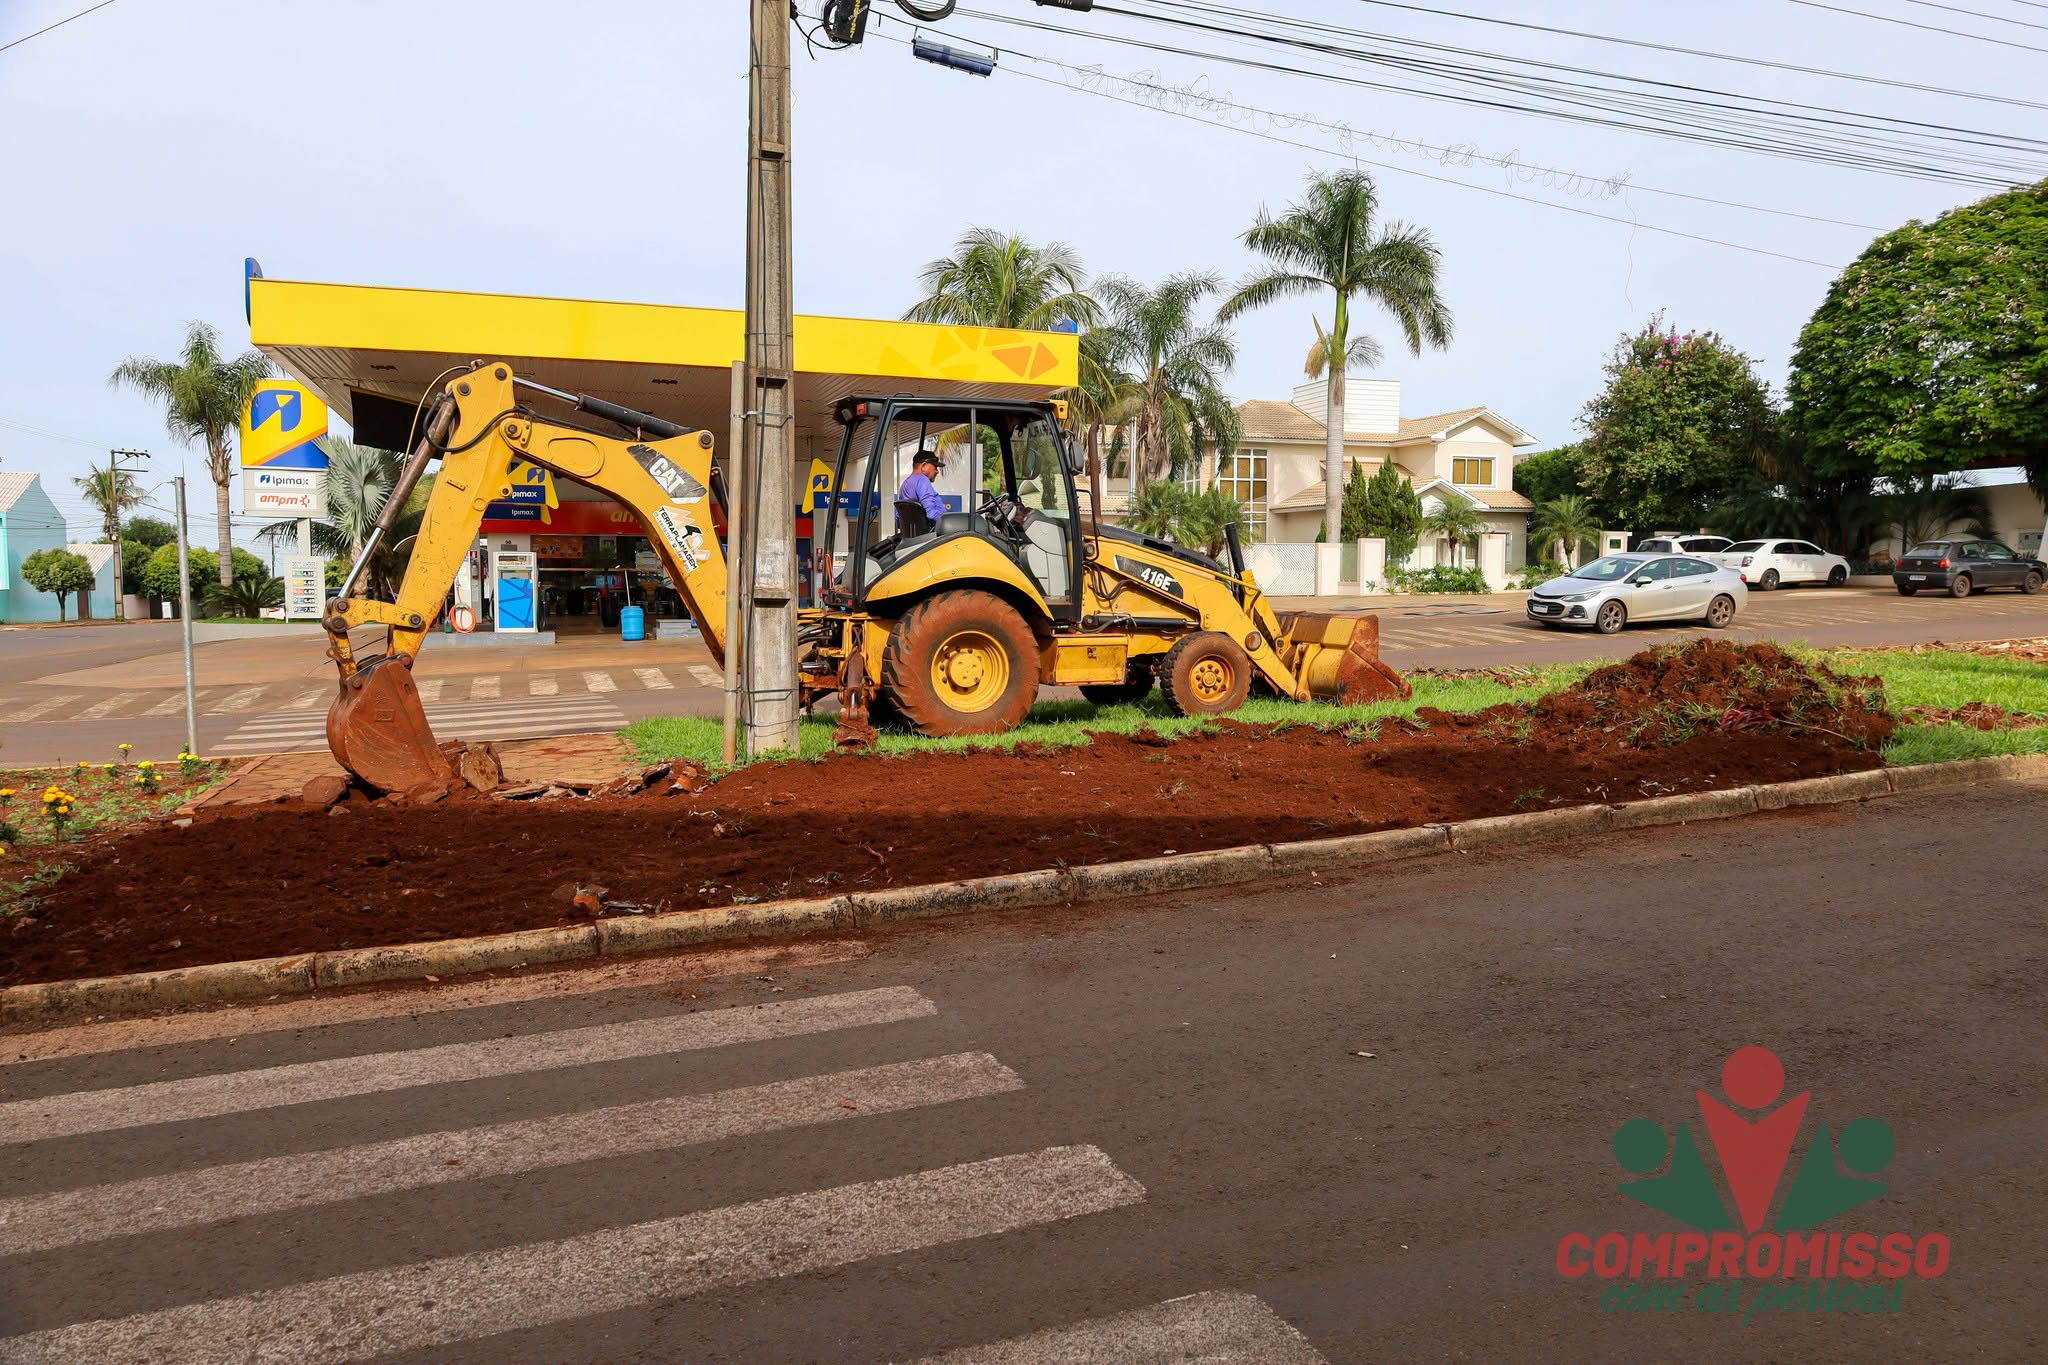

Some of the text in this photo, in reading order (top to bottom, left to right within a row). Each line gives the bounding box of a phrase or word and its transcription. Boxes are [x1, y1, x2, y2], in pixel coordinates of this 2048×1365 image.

[649, 457, 685, 494] CAT
[259, 495, 299, 506] ampm
[511, 491, 537, 499] pimax
[824, 495, 849, 504] Ipax
[658, 506, 698, 570] TERRAPLANAGEM
[1140, 567, 1176, 592] 416E
